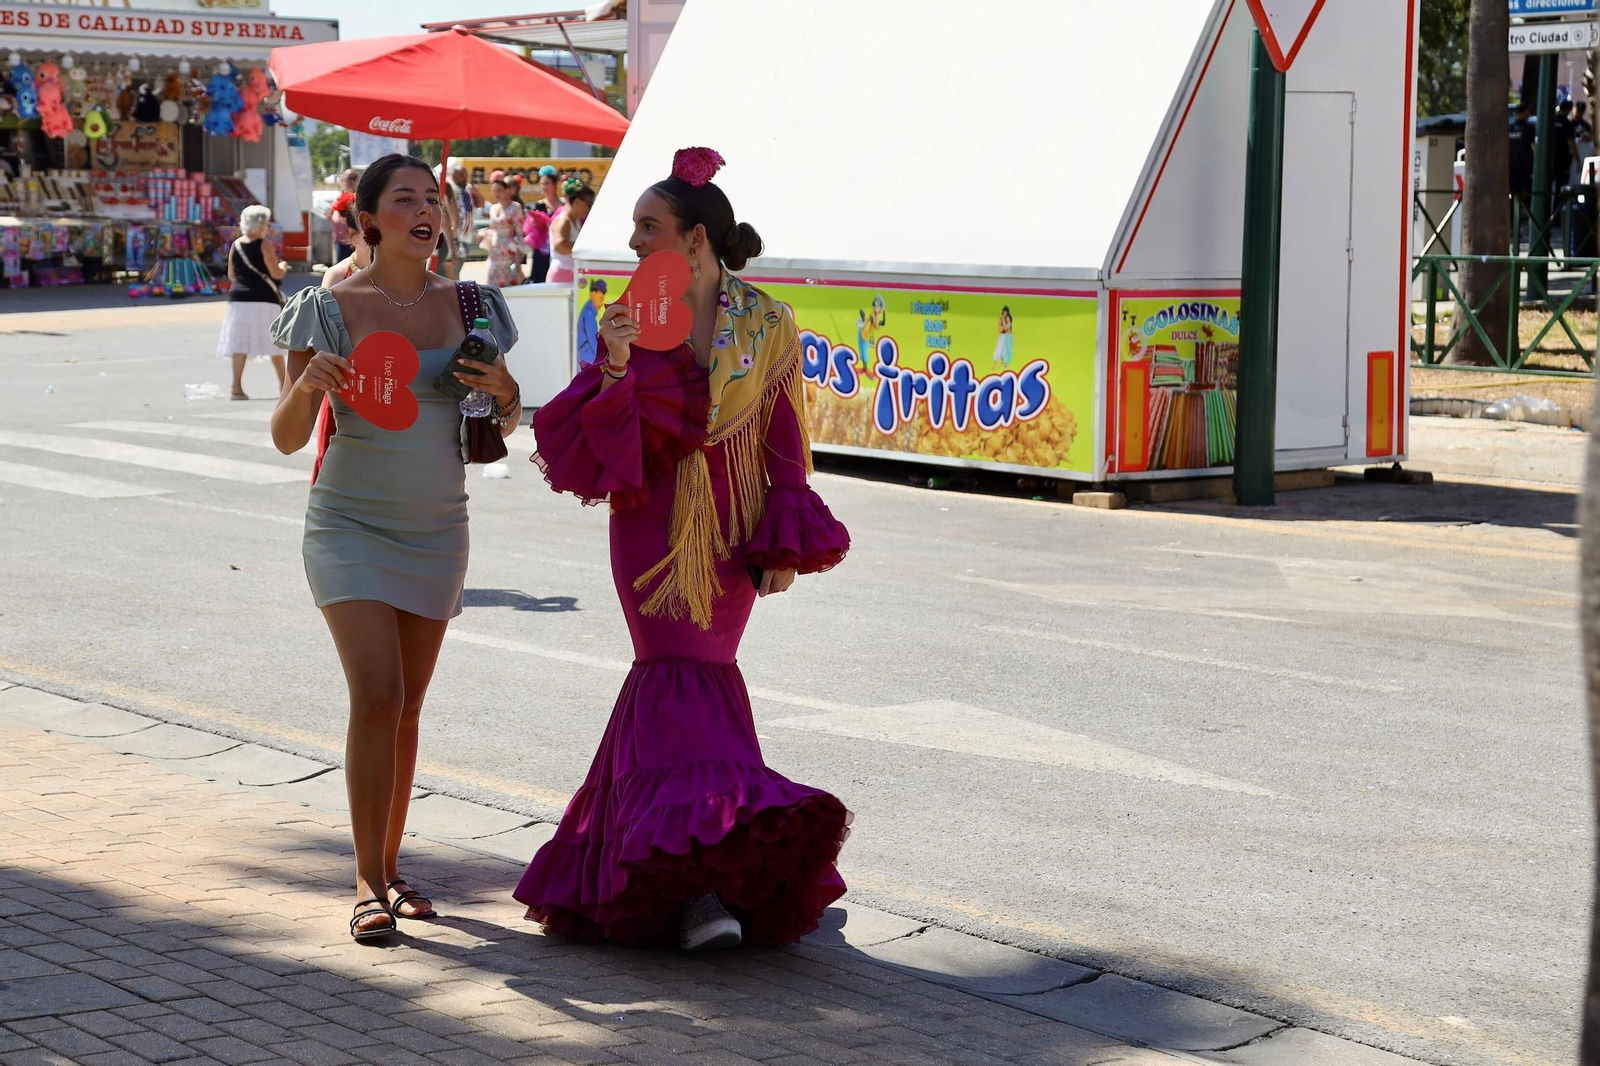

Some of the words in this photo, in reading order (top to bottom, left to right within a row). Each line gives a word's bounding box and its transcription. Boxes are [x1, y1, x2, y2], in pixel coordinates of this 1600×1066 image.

[0, 10, 30, 26] ES
[38, 12, 70, 29] DE
[78, 14, 185, 34] CALIDAD
[191, 20, 304, 40] SUPREMA
[1530, 31, 1568, 43] Ciudad
[658, 279, 667, 296] love
[657, 297, 668, 325] Málaga
[1143, 302, 1240, 336] GOLOSINAS
[1171, 331, 1198, 340] DULCE
[384, 360, 393, 376] love
[382, 377, 393, 404] Málaga
[874, 336, 1049, 435] fritas
